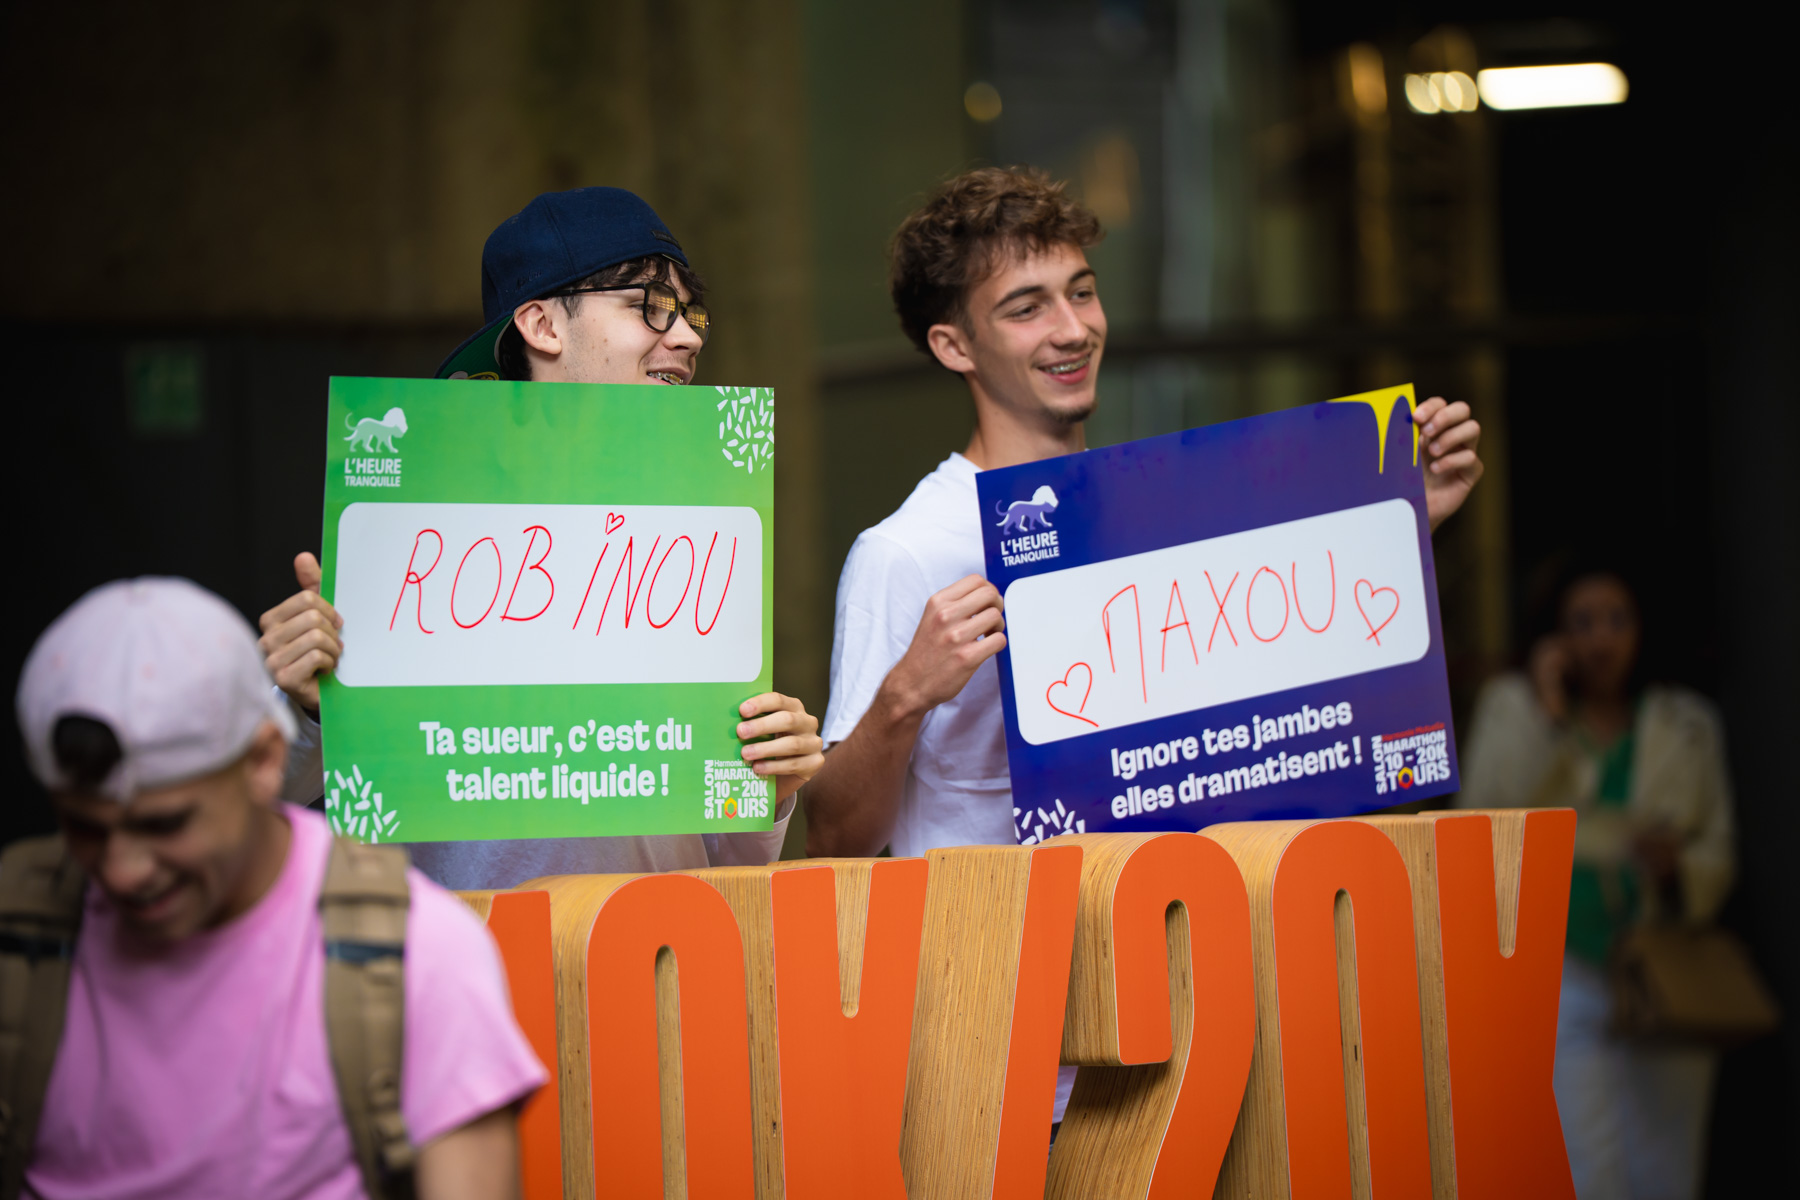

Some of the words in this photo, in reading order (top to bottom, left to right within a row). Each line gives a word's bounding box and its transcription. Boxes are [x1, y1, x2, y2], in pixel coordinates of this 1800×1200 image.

[344, 457, 402, 474] L'HEURE
[344, 475, 401, 487] TRANQUILLE
[1000, 530, 1059, 556] L'HEURE
[1002, 546, 1060, 567] TRANQUILLE
[420, 721, 457, 755] Ta
[462, 725, 563, 758] sueur,
[568, 719, 650, 753] c'est
[656, 718, 693, 751] du
[1110, 736, 1199, 780] Ignore
[1202, 724, 1250, 755] tes
[1252, 701, 1353, 751] jambes
[1383, 728, 1447, 755] MARATHON
[714, 759, 743, 768] Harmonie
[1371, 734, 1388, 795] SALON
[1384, 751, 1404, 771] 10
[1415, 741, 1448, 765] 20K
[446, 766, 547, 801] talent
[553, 762, 656, 804] liquide
[714, 767, 768, 781] MARATH
[1111, 784, 1176, 819] elles
[1178, 741, 1351, 804] dramatisent
[1386, 759, 1451, 792] TOURS
[704, 759, 714, 820] SALON
[714, 781, 730, 798] 10
[741, 780, 769, 798] 20K
[714, 797, 769, 819] TOURS
